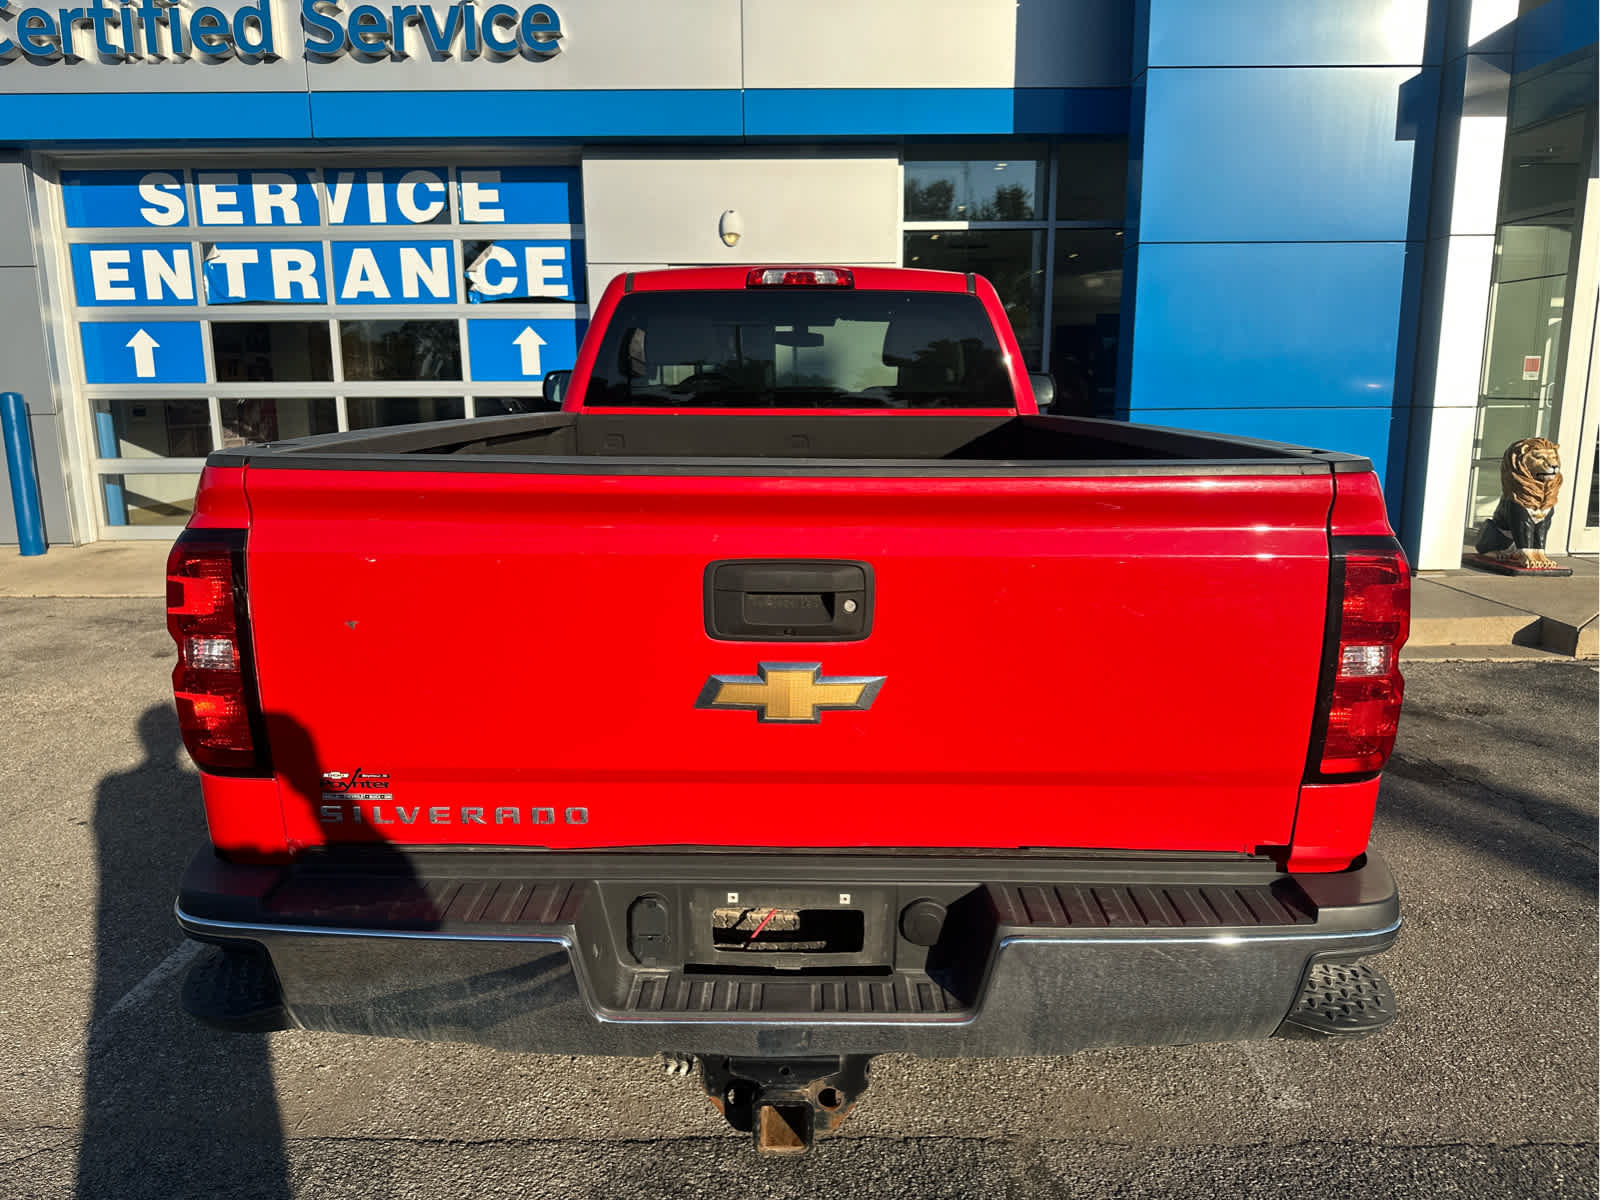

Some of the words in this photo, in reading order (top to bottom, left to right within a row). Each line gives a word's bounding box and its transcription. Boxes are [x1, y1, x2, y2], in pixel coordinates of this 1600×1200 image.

[302, 0, 562, 54] Service
[138, 171, 505, 226] SERVICE
[89, 245, 569, 301] ENTRANCE
[320, 805, 590, 825] SILVERADO
